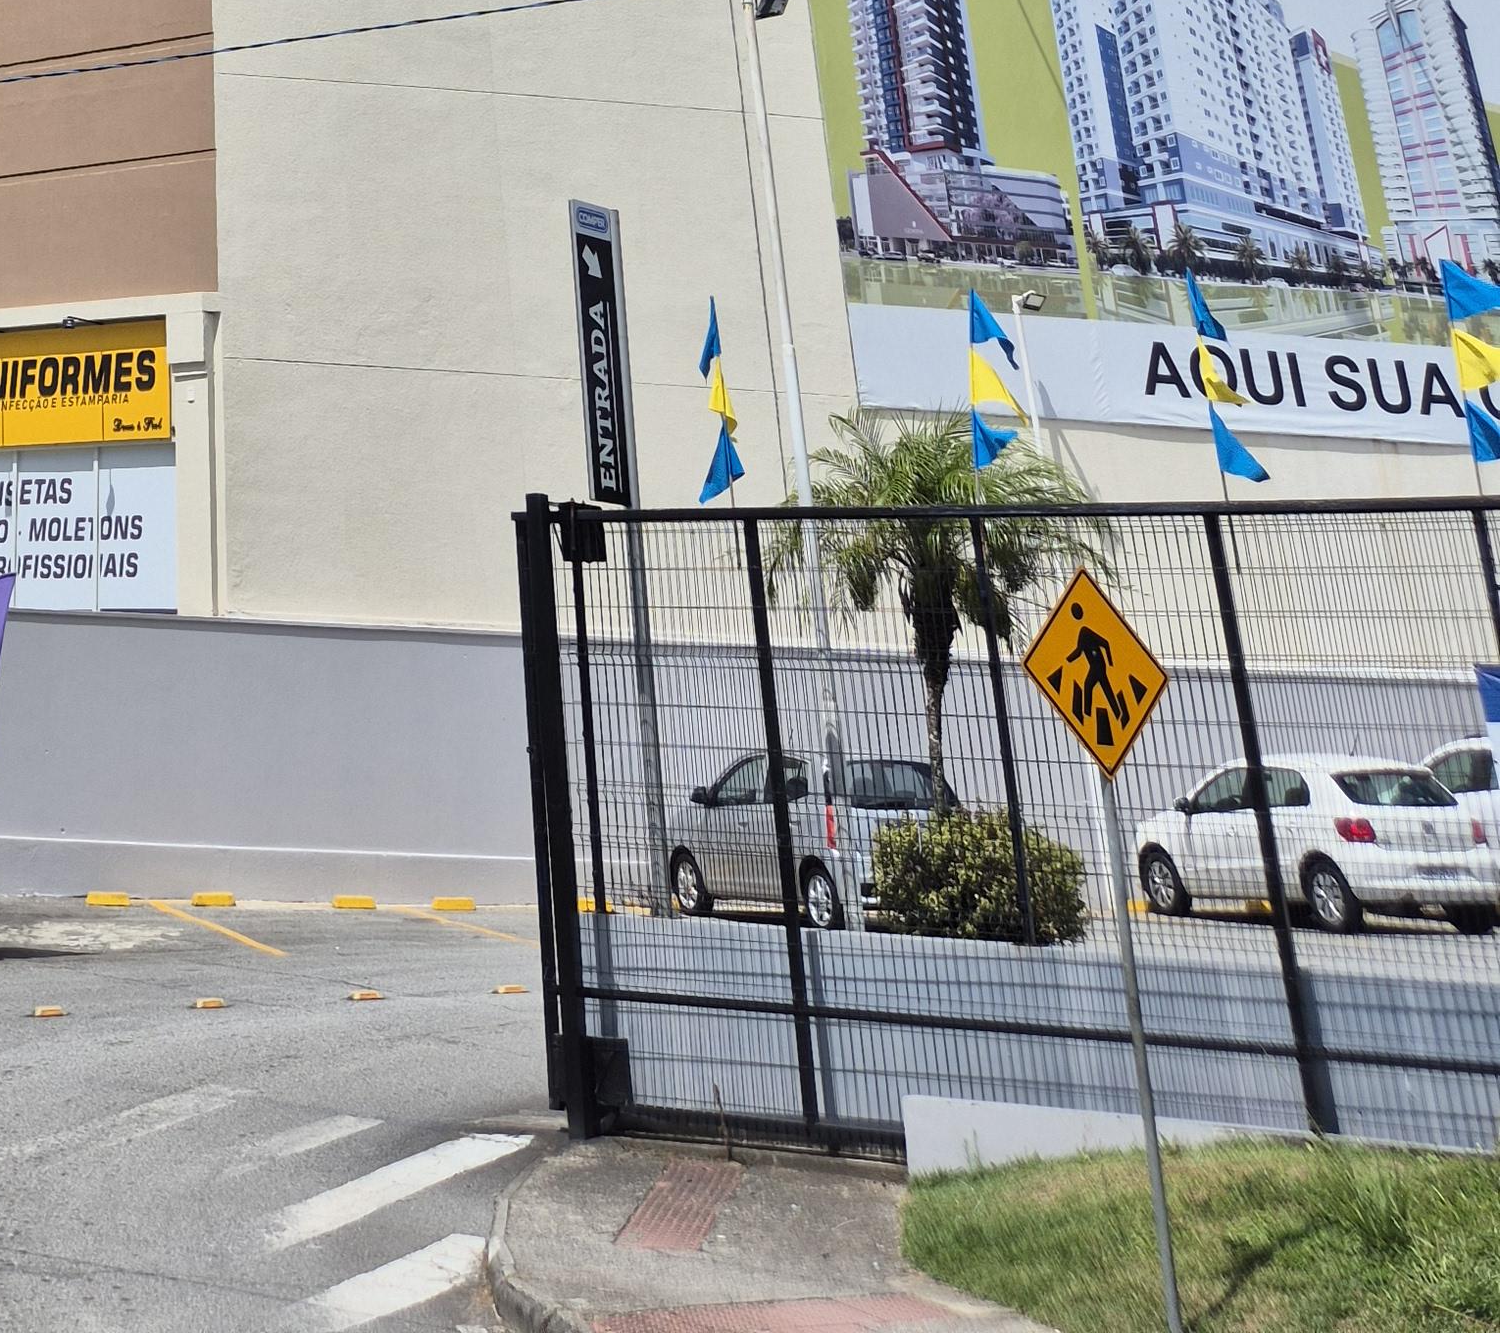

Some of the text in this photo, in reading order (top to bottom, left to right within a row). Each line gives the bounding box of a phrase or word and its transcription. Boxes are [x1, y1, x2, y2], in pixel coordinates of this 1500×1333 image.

[51, 397, 57, 408] E
[61, 393, 130, 408] ESTAMPARIA
[588, 300, 617, 493] ENTRADA
[1145, 341, 1307, 408] AQUI
[1324, 354, 1466, 419] SUA
[28, 515, 144, 542] MOLETONS
